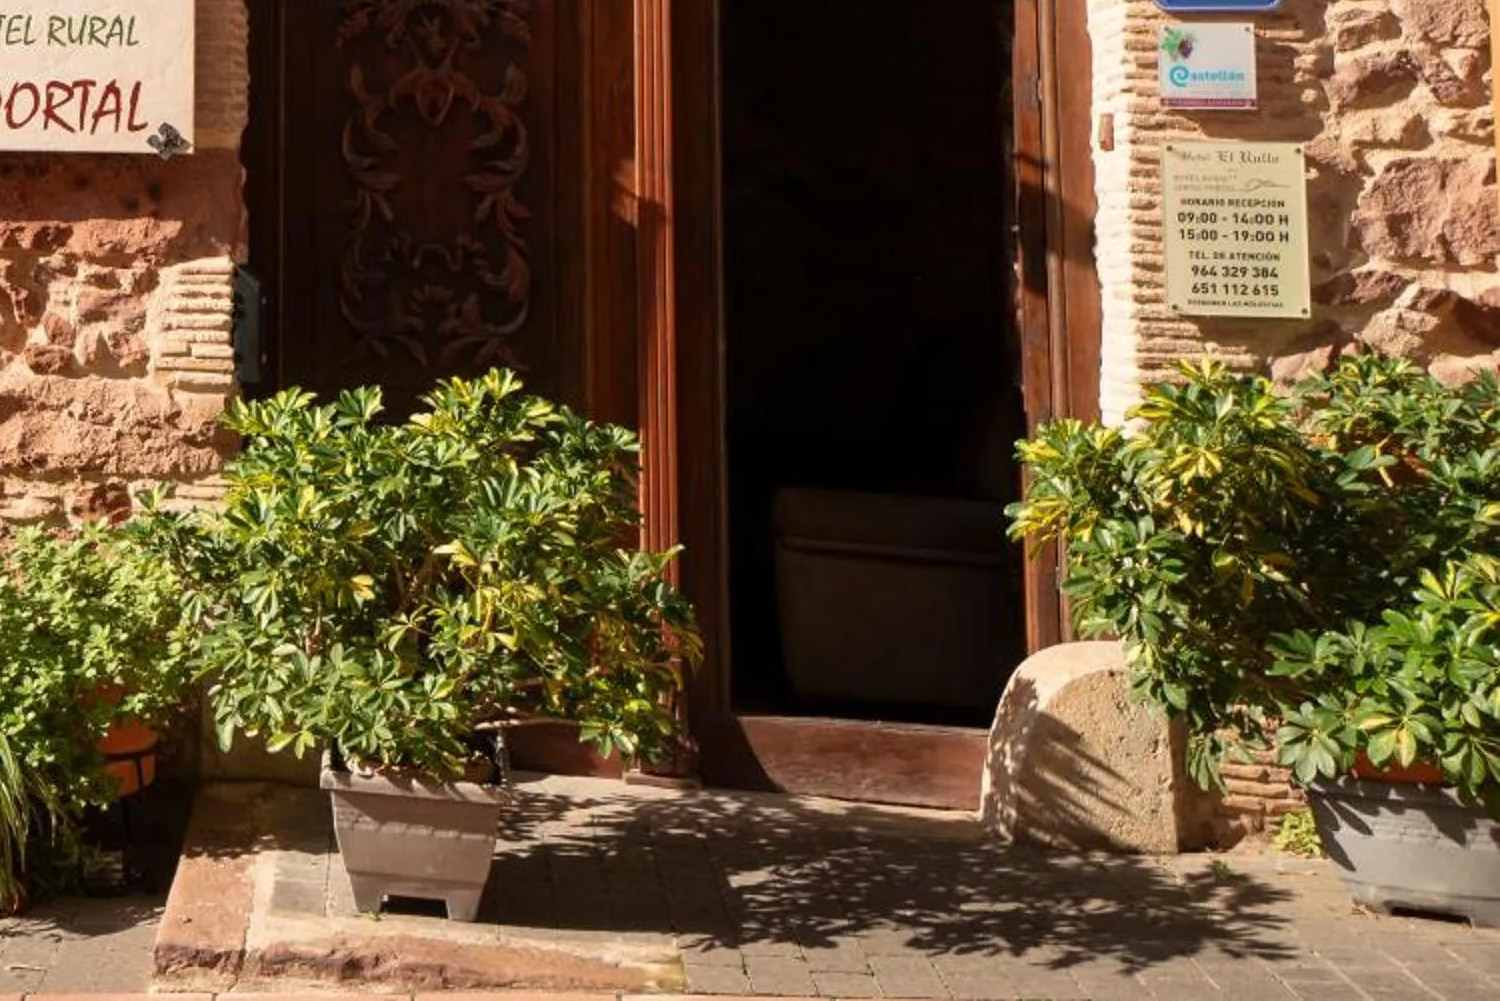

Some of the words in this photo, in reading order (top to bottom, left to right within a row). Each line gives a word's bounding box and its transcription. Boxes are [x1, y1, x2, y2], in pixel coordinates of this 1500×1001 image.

[47, 14, 141, 48] RURAL
[1177, 212, 1217, 224] 09:00
[1233, 213, 1275, 226] 14:00
[1279, 215, 1289, 226] H
[1179, 229, 1218, 241] 15:00
[1233, 231, 1275, 243] 19:00
[1279, 232, 1289, 243] H
[1191, 265, 1217, 276] 964
[1221, 266, 1248, 278] 329
[1252, 266, 1279, 279] 384
[1191, 282, 1217, 294] 651
[1222, 284, 1249, 296] 112
[1252, 284, 1279, 296] 615
